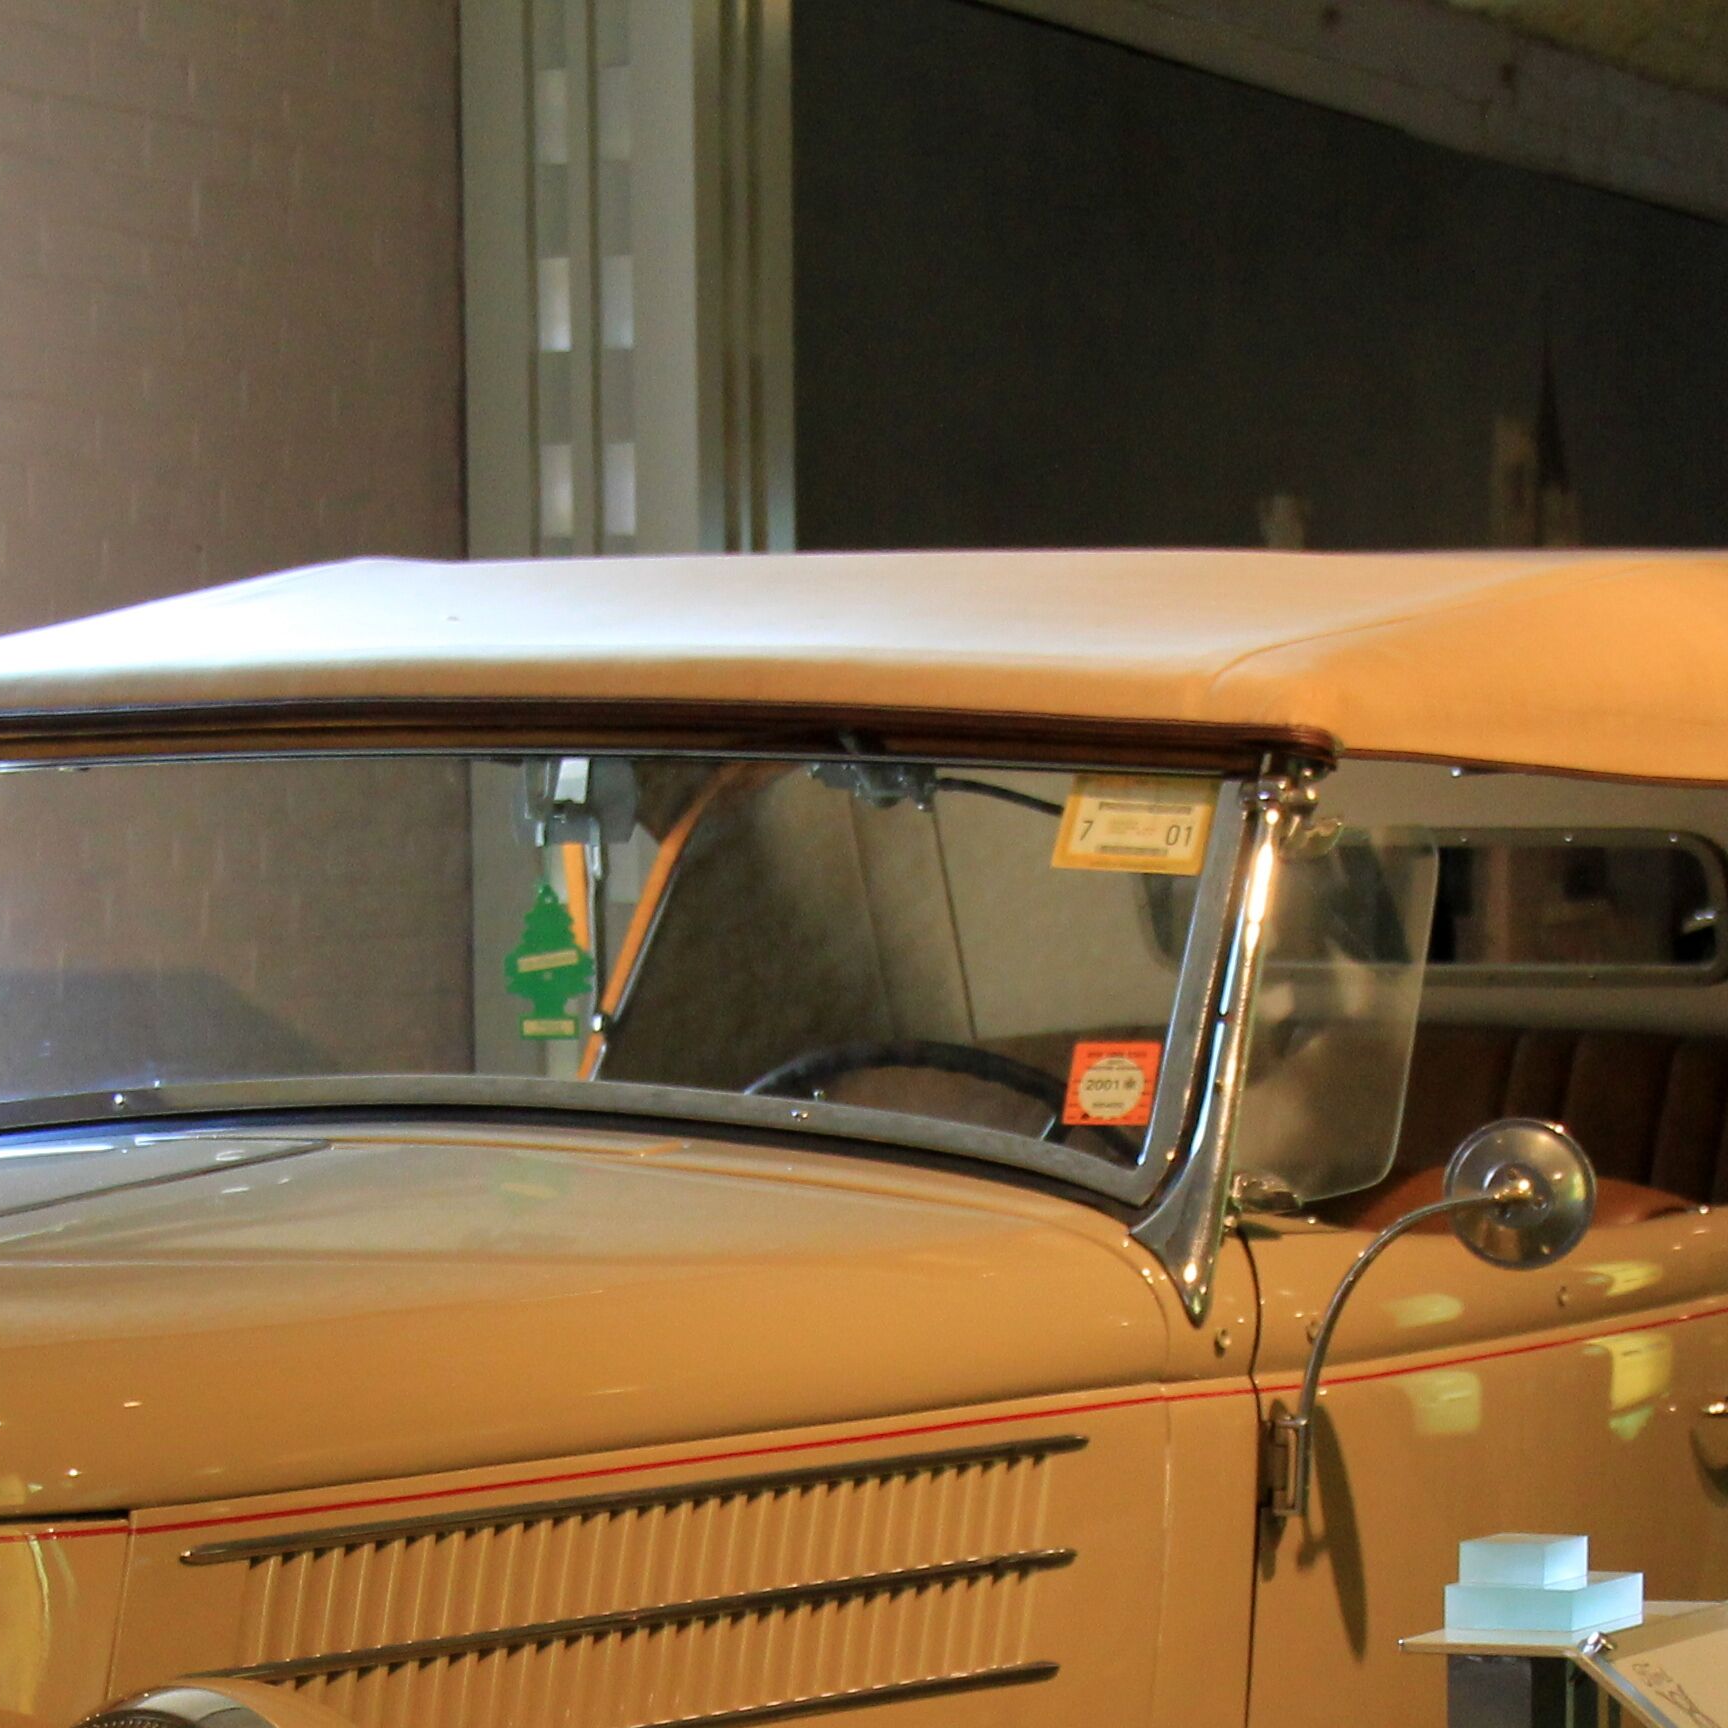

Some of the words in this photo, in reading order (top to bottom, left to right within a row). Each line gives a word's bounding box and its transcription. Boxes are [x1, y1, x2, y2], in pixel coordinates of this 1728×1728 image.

[1079, 820, 1095, 842] 7
[1165, 825, 1194, 847] 01
[1085, 1079, 1120, 1092] 2001
